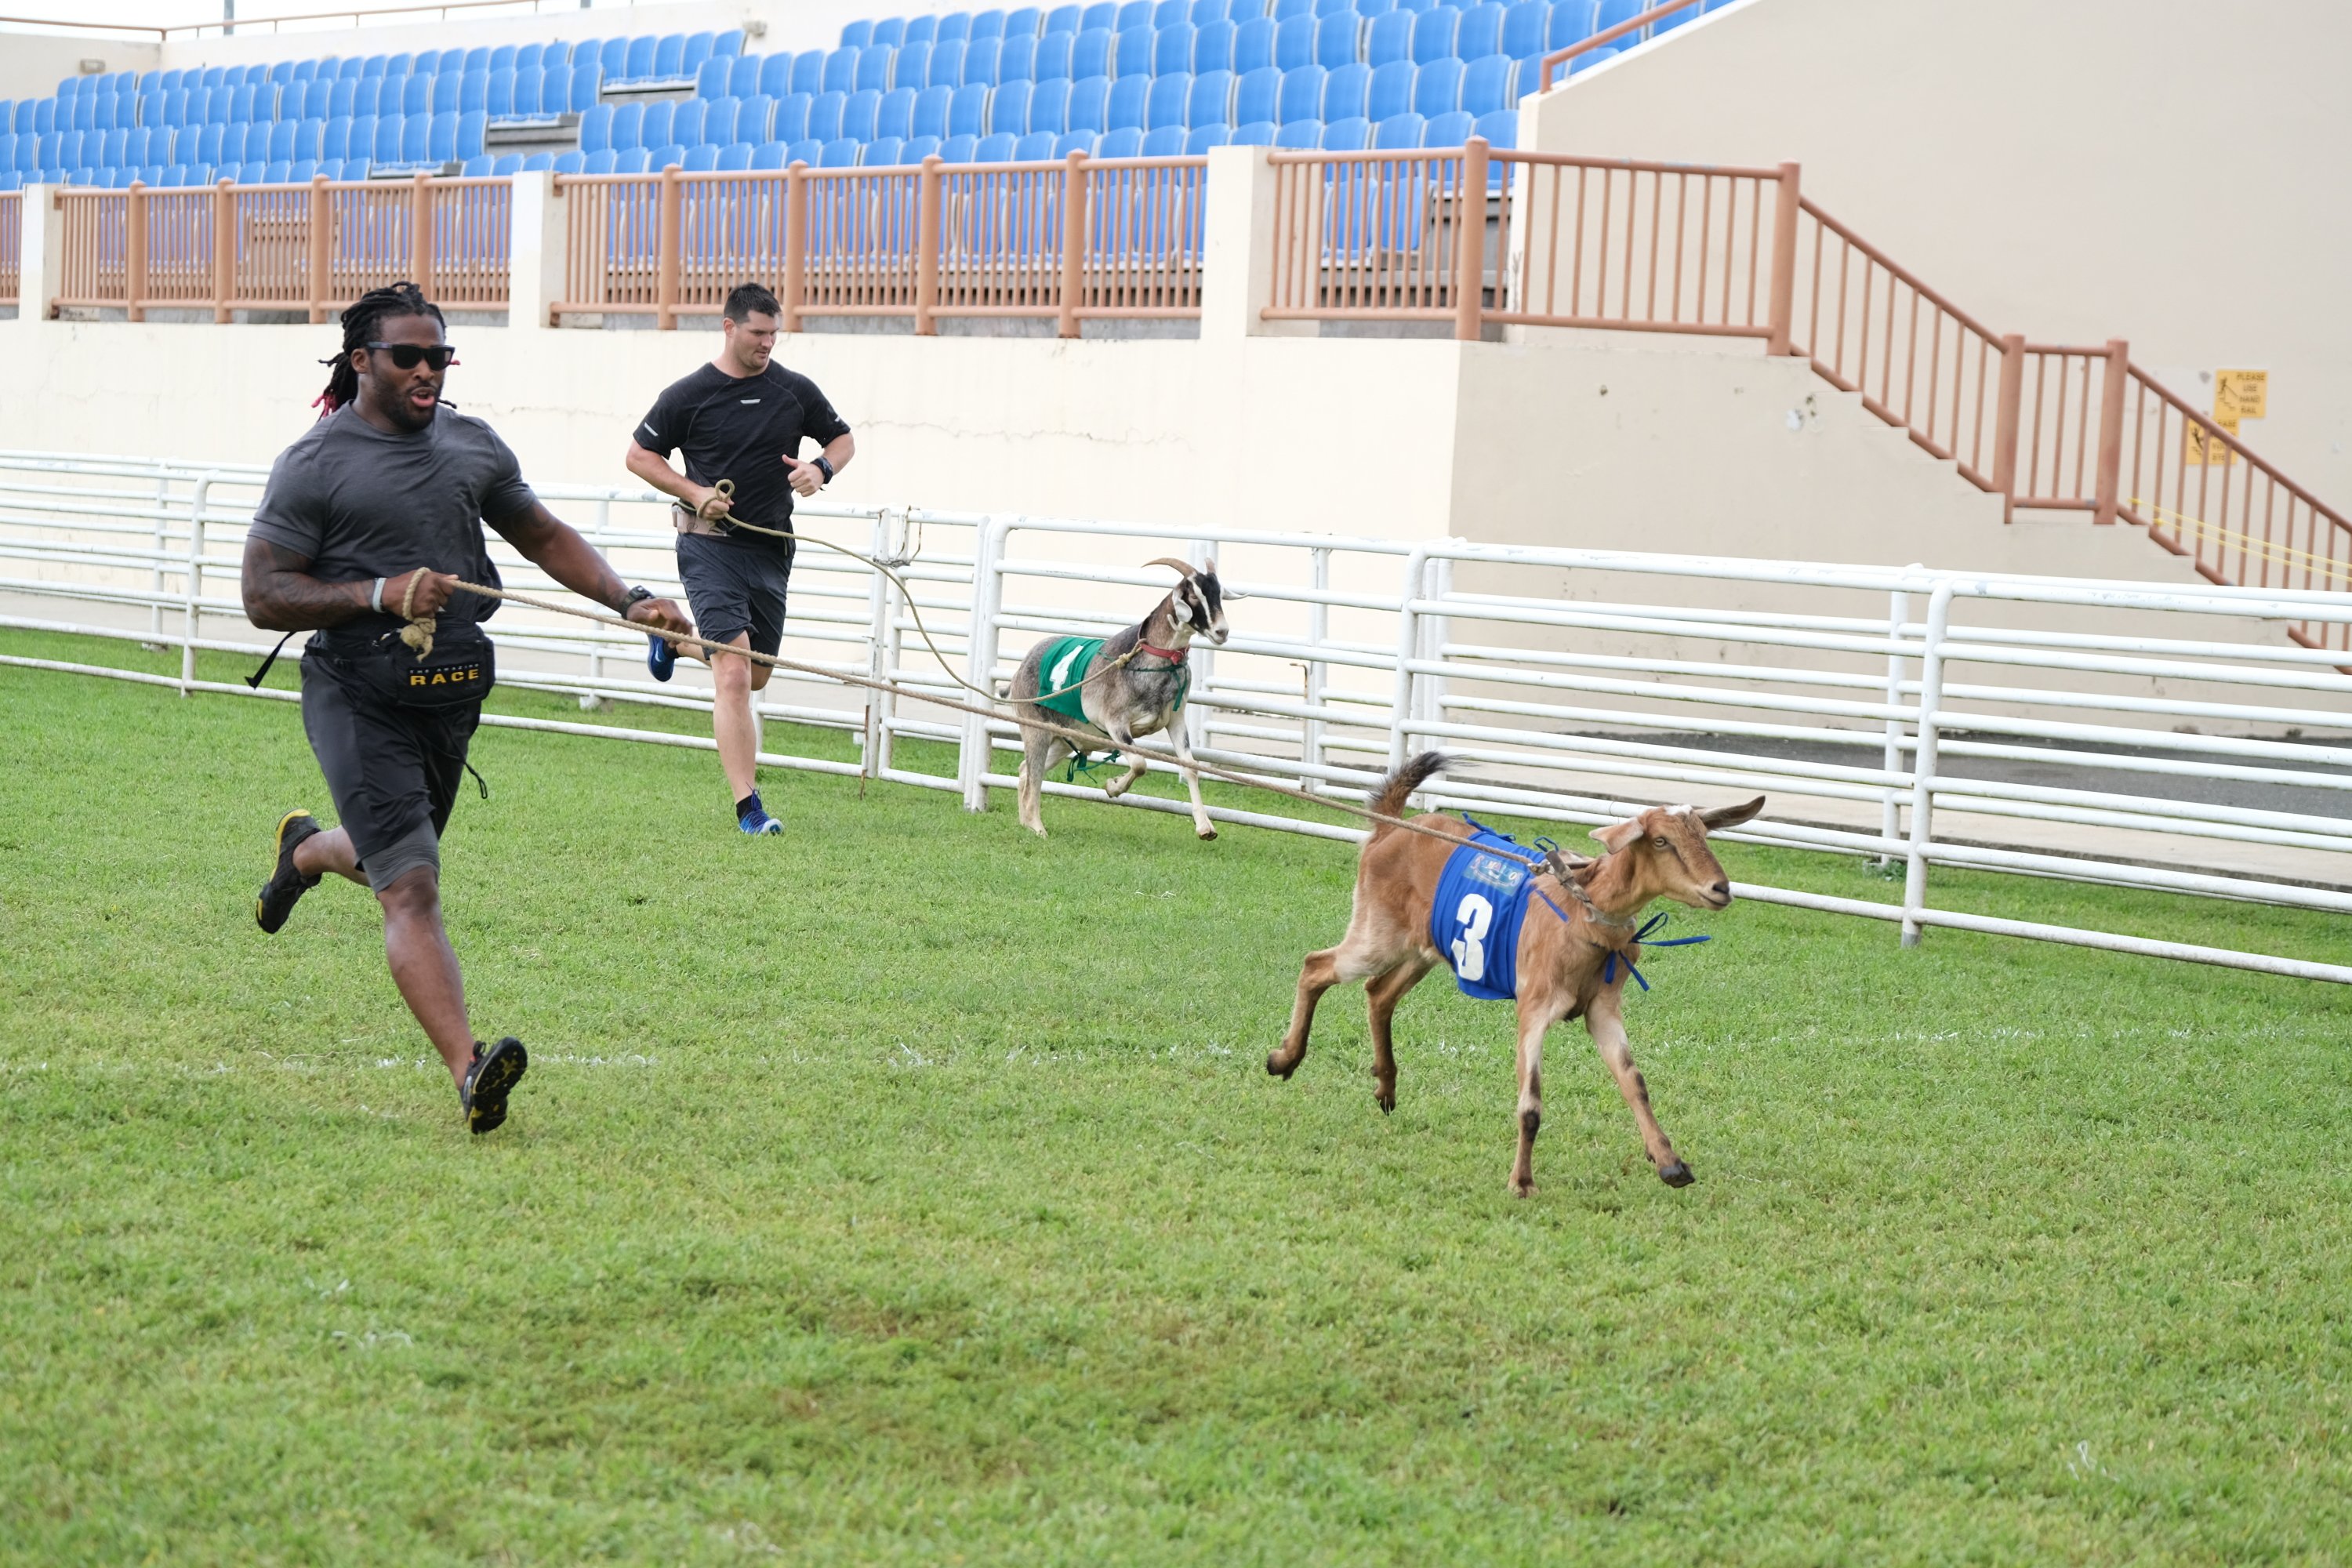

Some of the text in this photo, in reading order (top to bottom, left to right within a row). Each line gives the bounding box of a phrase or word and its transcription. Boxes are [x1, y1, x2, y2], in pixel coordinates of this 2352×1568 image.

[2237, 372, 2265, 381] PLEASE
[2243, 383, 2257, 392] USE
[2241, 405, 2256, 414] RAIL
[410, 669, 480, 686] RACE
[1451, 893, 1493, 981] 3
